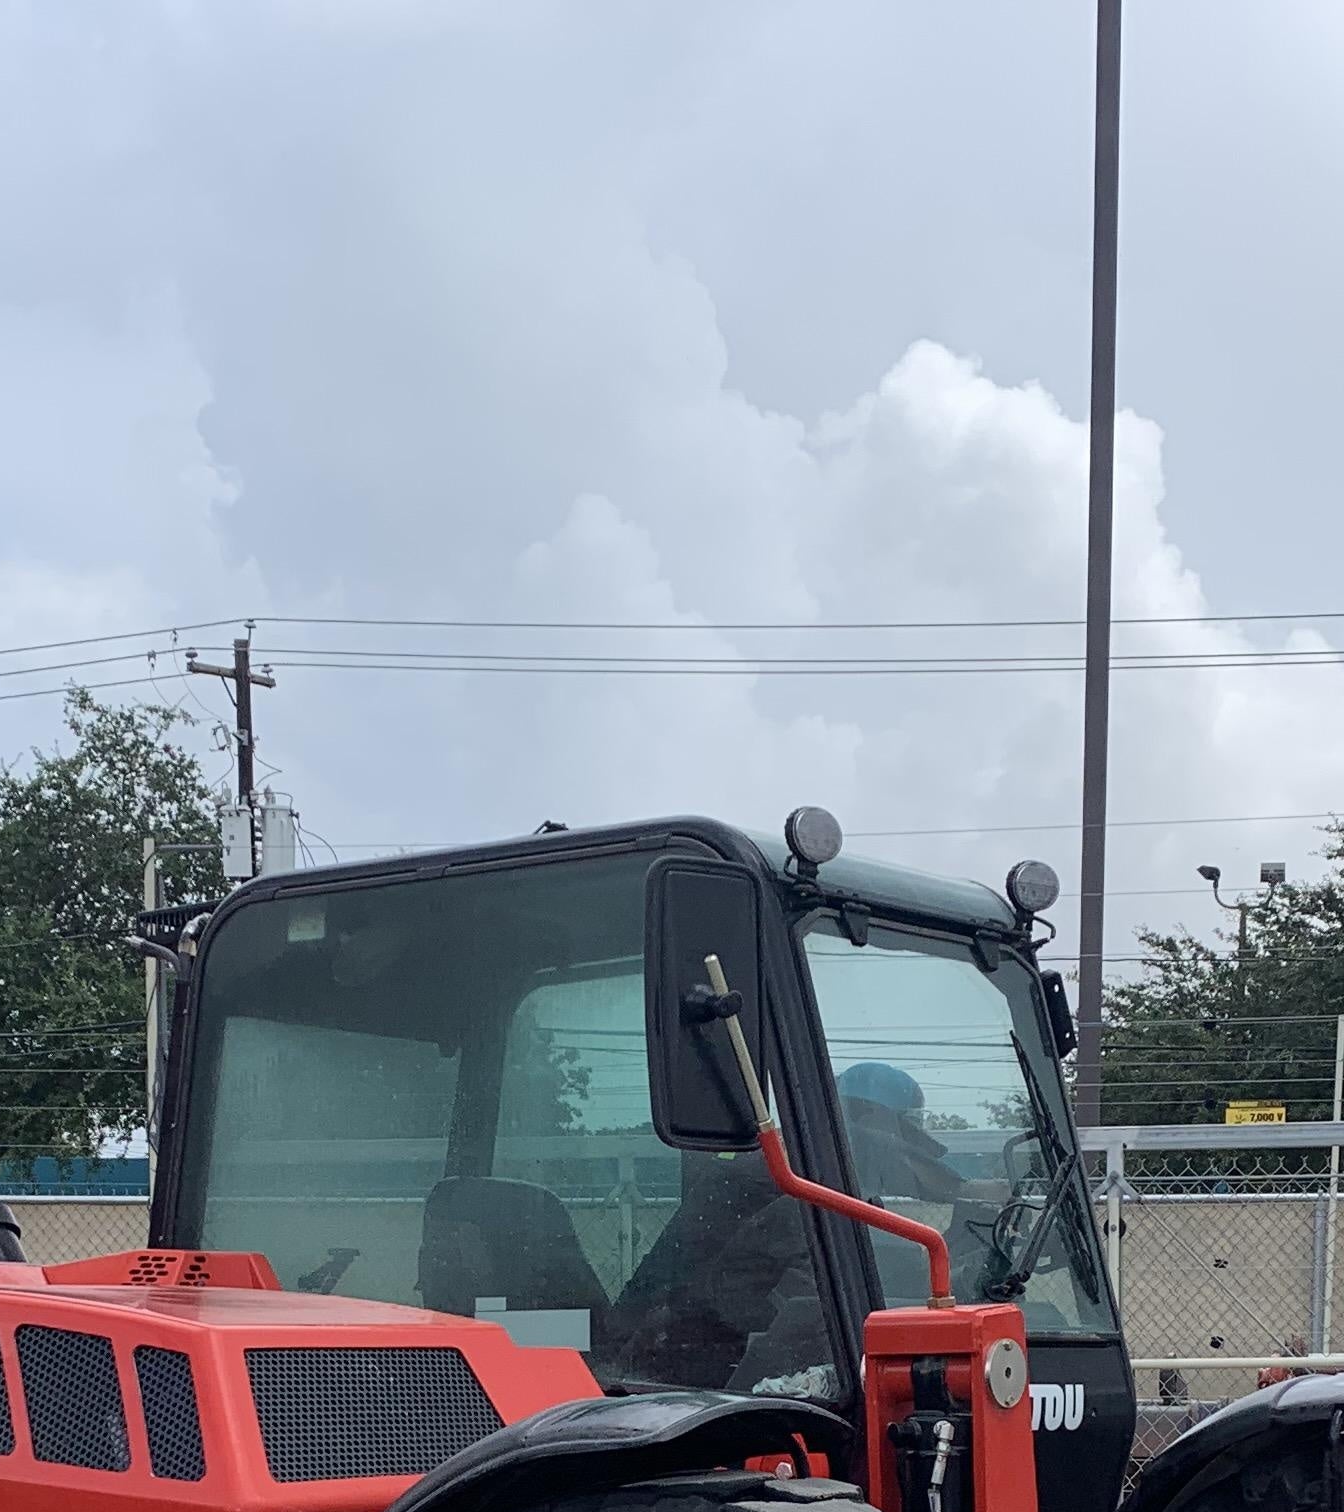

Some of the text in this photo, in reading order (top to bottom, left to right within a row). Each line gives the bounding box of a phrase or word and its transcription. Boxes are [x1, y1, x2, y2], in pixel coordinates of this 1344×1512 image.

[1249, 1112, 1284, 1123] 7,000 V
[1028, 1383, 1085, 1432] TOU
